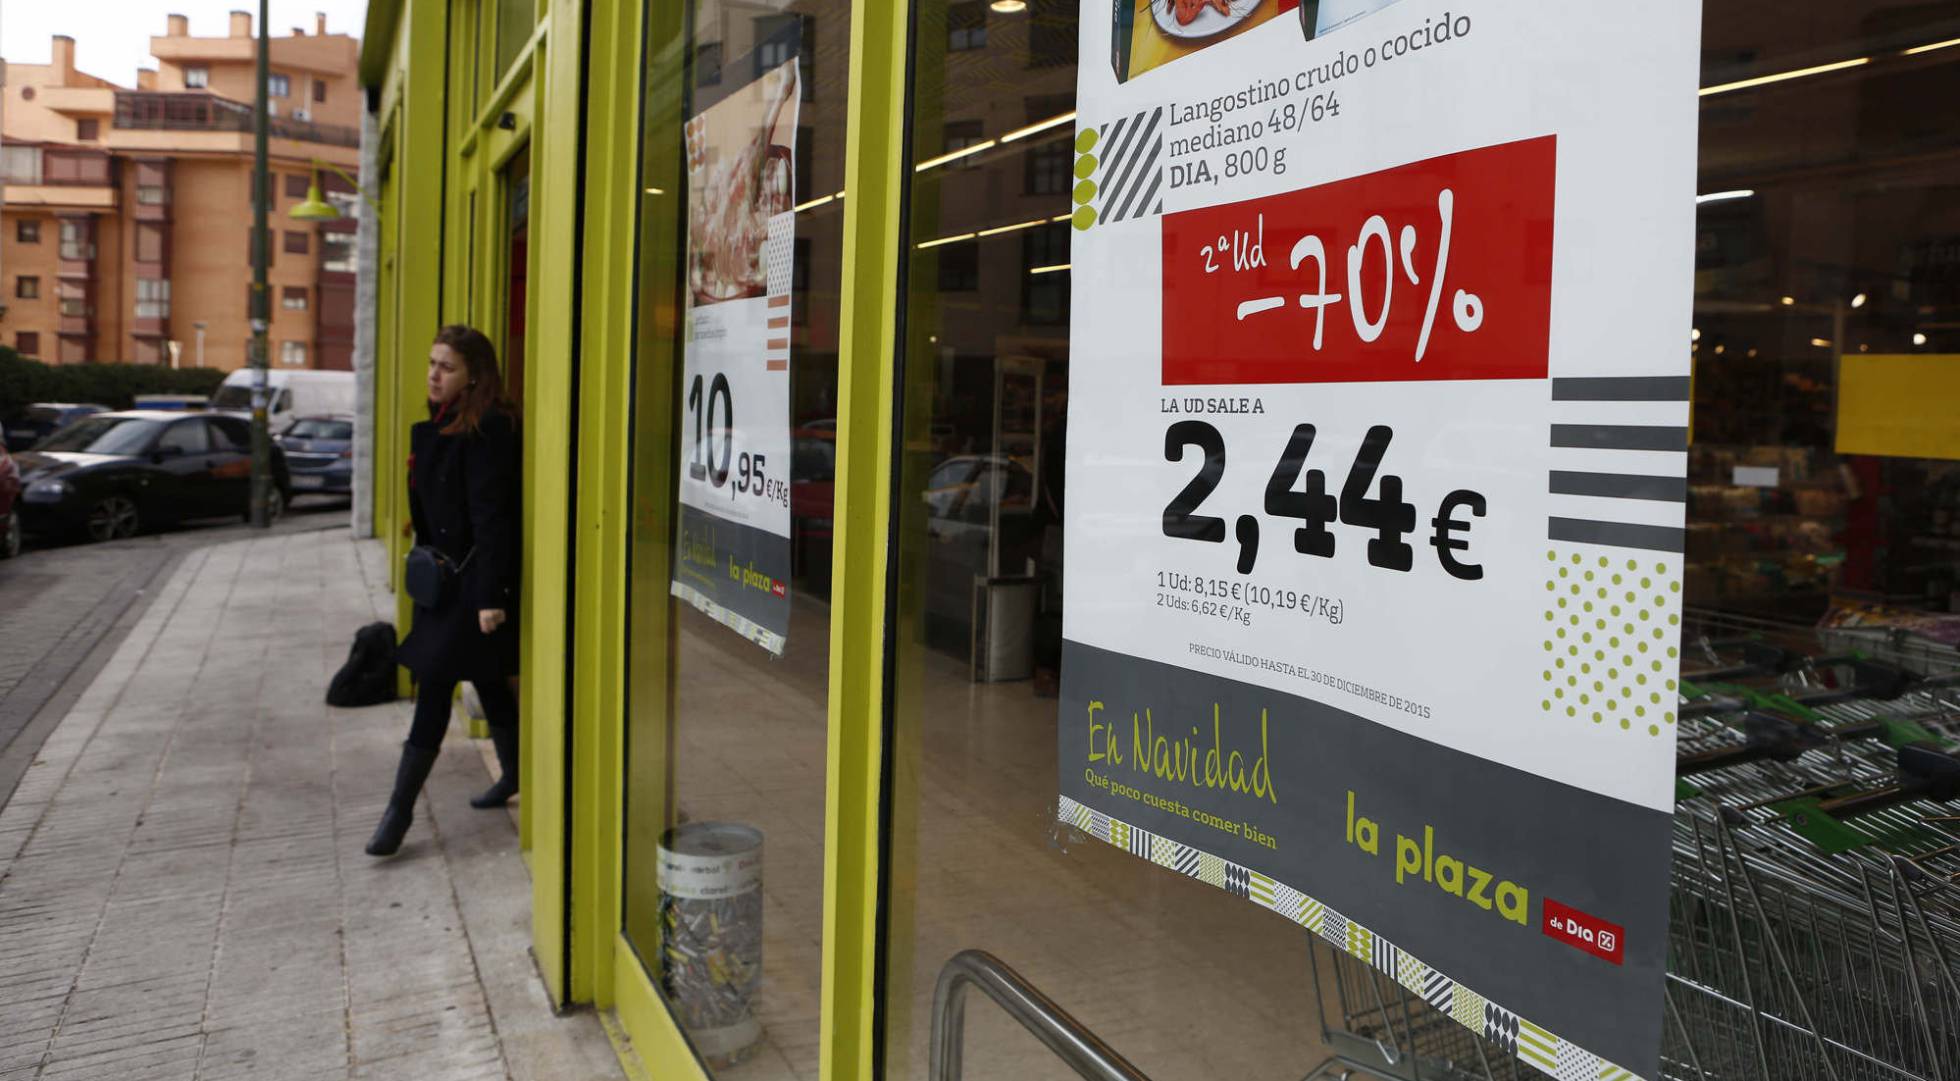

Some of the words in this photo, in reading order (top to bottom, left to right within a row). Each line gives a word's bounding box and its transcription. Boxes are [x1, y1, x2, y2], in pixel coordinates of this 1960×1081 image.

[1170, 78, 1290, 126] Langostino
[1295, 51, 1359, 92] crudo
[1363, 47, 1377, 68] o
[1381, 12, 1472, 61] cocido
[1170, 121, 1264, 157] mediano
[1268, 90, 1341, 133] 48/64
[1170, 159, 1219, 189] DIA,
[1224, 146, 1269, 178] 800
[1273, 147, 1287, 175] g
[1161, 398, 1179, 413] LA
[1184, 398, 1204, 413] UD
[1207, 398, 1250, 414] SALE
[1252, 398, 1265, 414] A
[743, 561, 771, 592] plaza
[1156, 593, 1165, 606] 2
[1166, 594, 1190, 611] Uds:
[1157, 571, 1167, 588] 1
[1168, 572, 1192, 592] Ud:
[1189, 642, 1222, 660] PRECIO
[1223, 648, 1260, 668] VÁLIDO
[1260, 658, 1296, 677] HASTA
[1297, 666, 1310, 680] EL
[1311, 670, 1322, 684] 30
[1323, 674, 1336, 688] DE
[1336, 678, 1388, 706] DICIEMBRE
[1388, 695, 1403, 711] DE
[1404, 700, 1431, 719] 2015
[1088, 700, 1123, 766] En
[1133, 703, 1278, 805] Navidad
[1085, 768, 1109, 790] Qué
[1111, 779, 1141, 801] poco
[1143, 792, 1190, 818] cuesta
[1192, 809, 1241, 836] comer
[1243, 823, 1277, 849] bien
[1346, 790, 1379, 856] la
[1395, 824, 1529, 927] plaza
[1550, 916, 1563, 931] de
